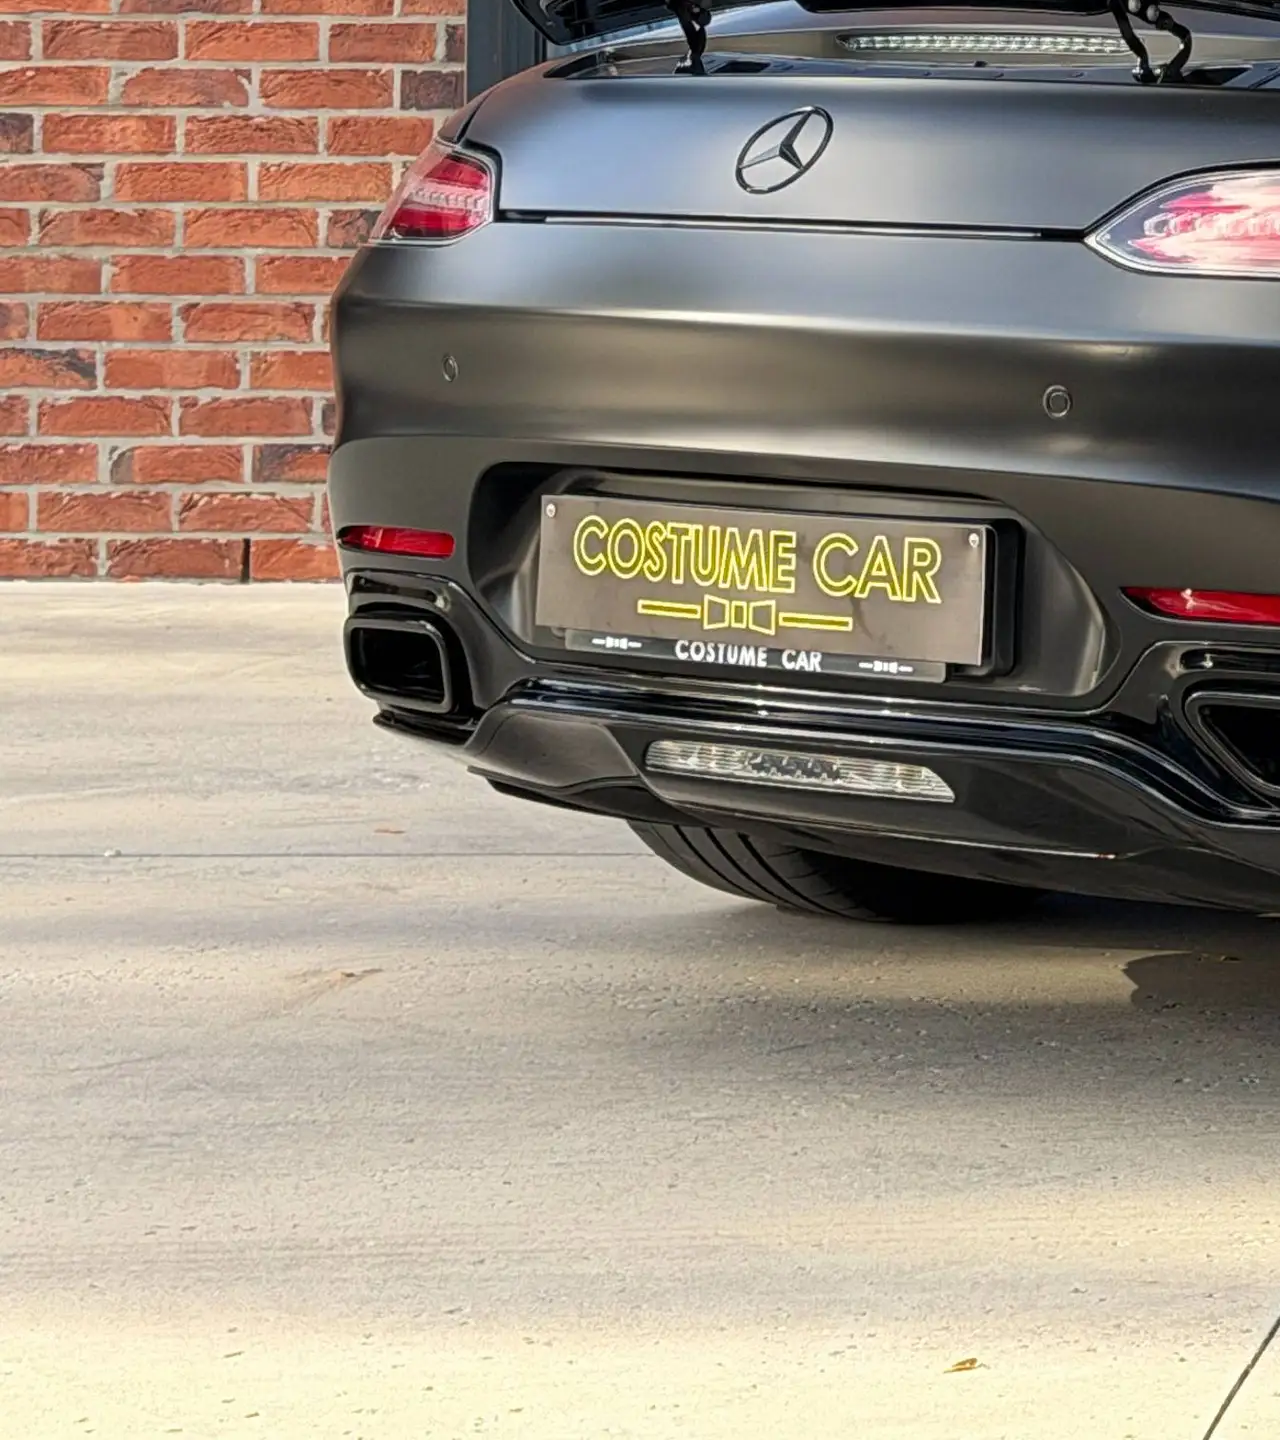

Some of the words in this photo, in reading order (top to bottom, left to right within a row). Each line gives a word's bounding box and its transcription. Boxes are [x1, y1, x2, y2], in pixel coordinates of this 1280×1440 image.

[573, 514, 797, 593] COSTUME
[811, 532, 943, 604] CAR
[674, 639, 768, 668] COSTUME
[781, 648, 823, 673] CAR
